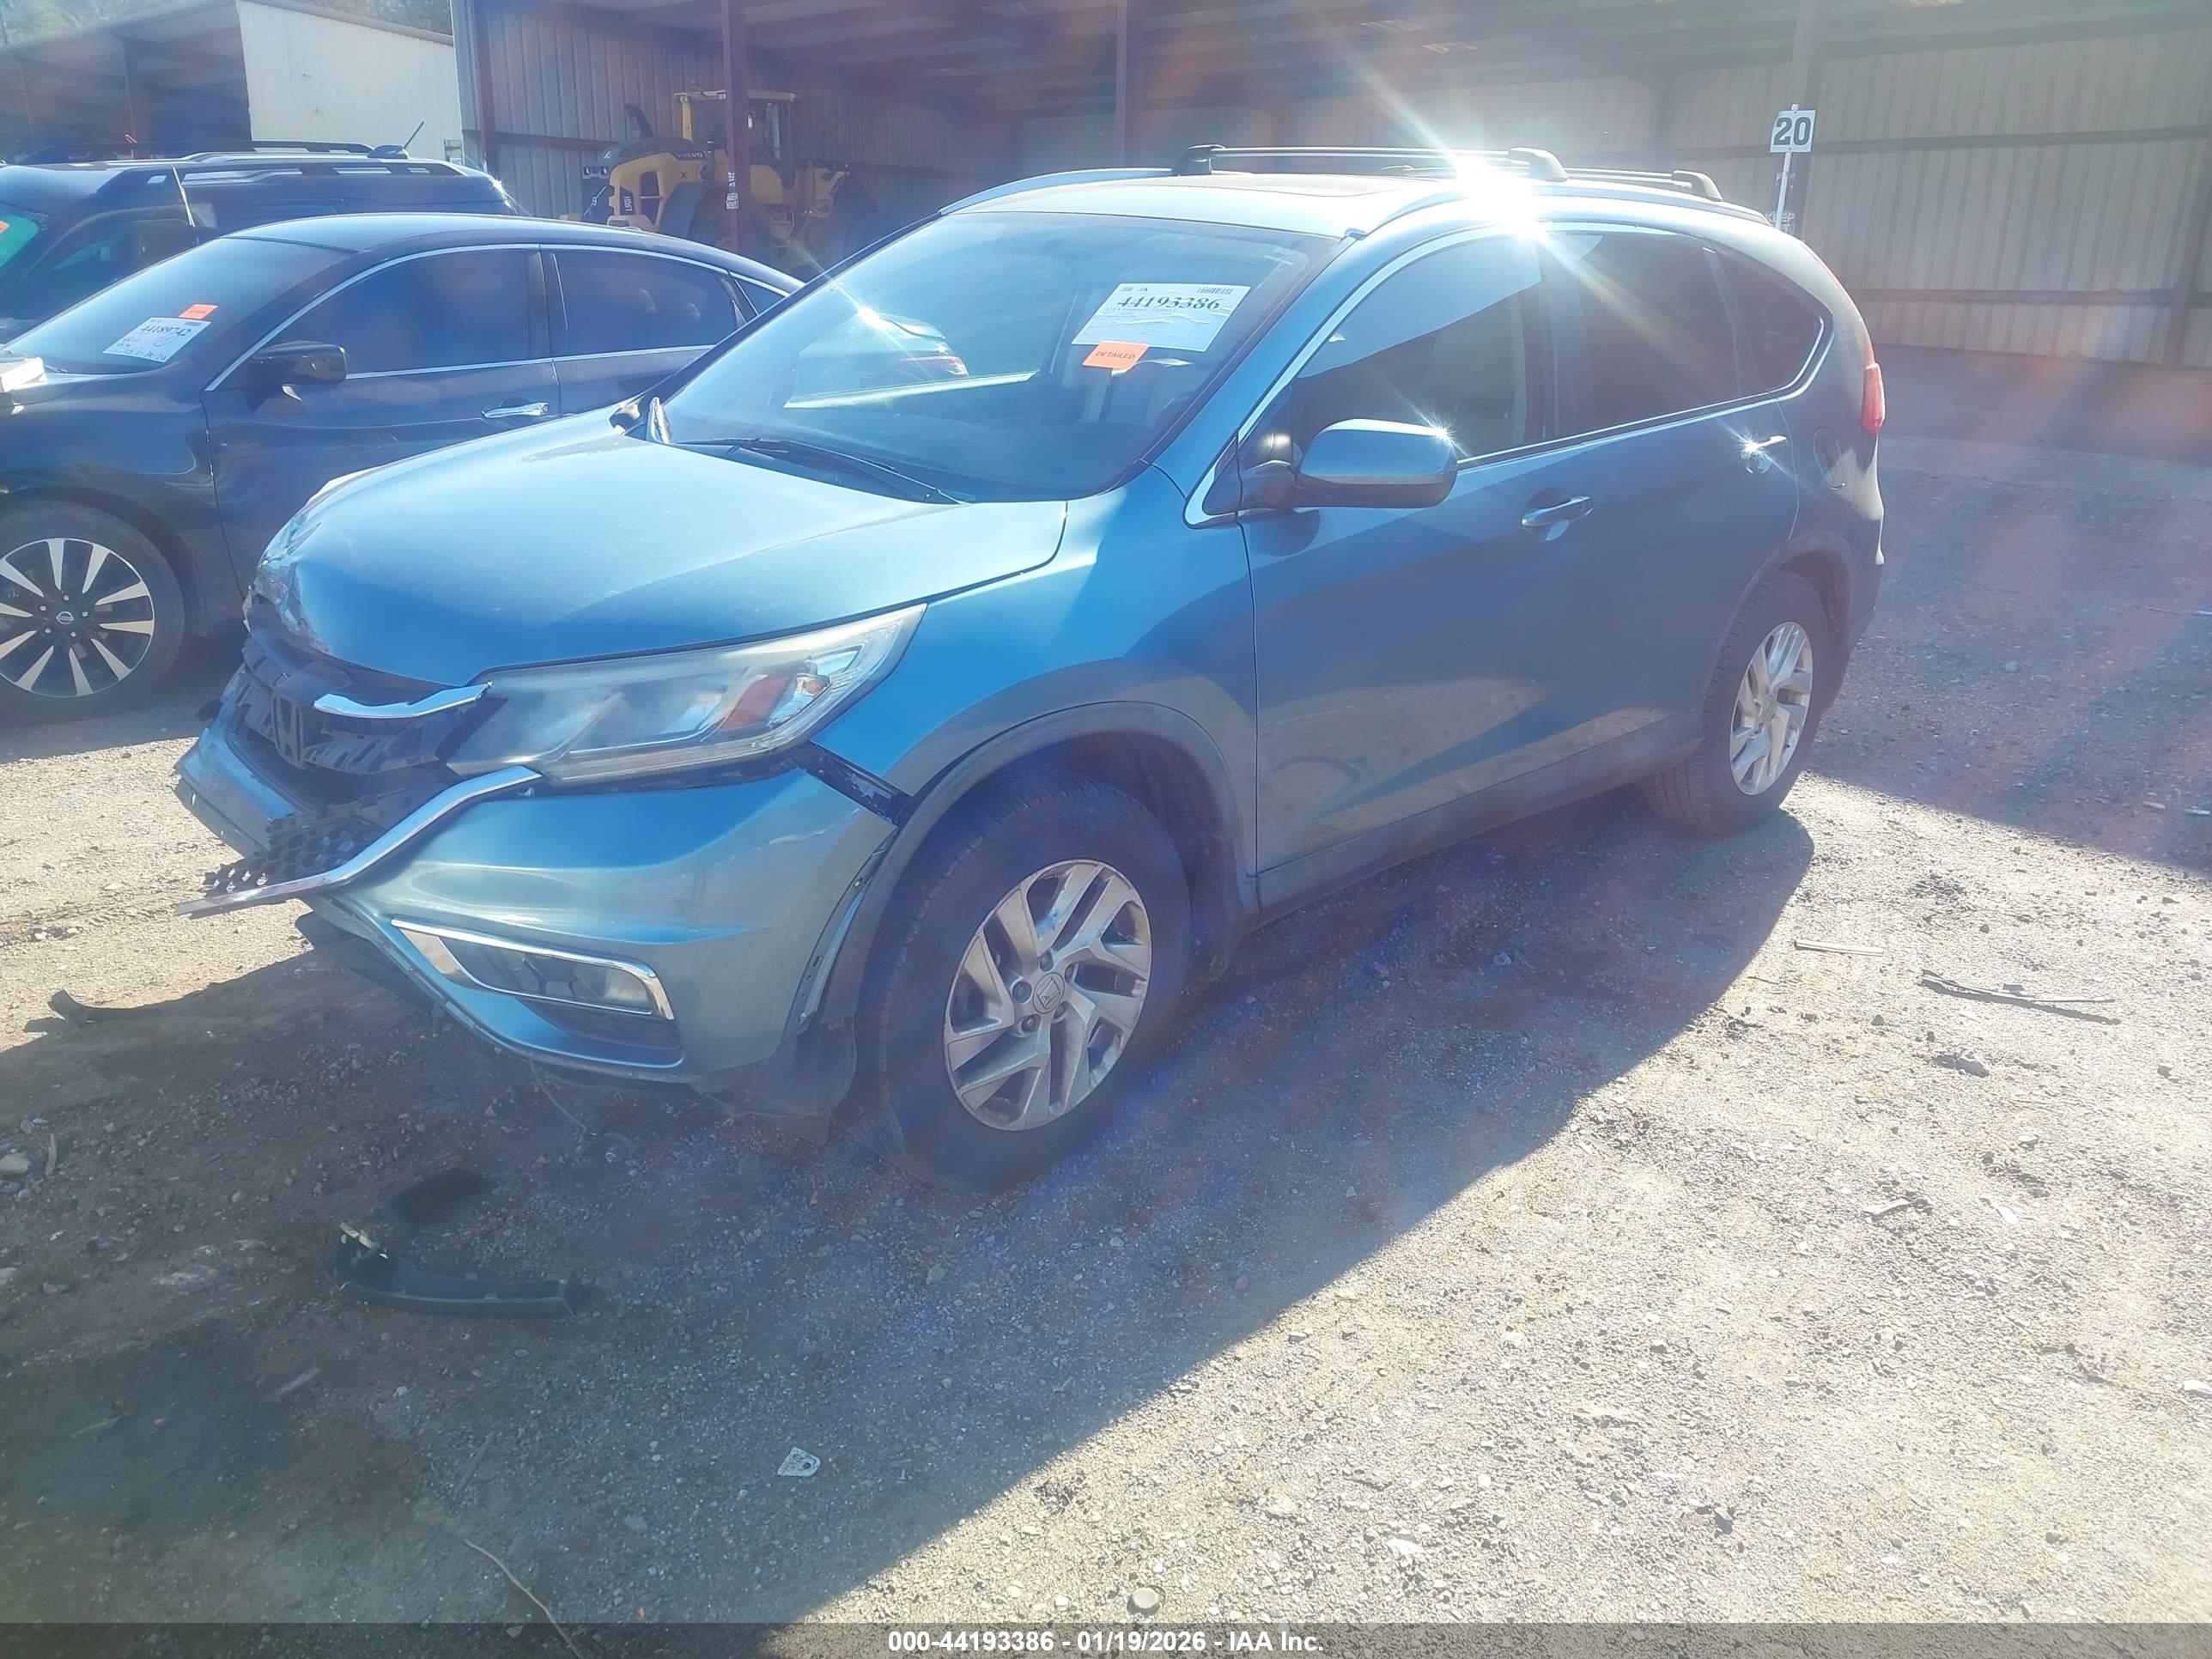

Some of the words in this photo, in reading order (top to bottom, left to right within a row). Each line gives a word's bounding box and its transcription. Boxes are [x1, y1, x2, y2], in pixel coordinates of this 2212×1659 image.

[1773, 117, 1811, 145] 20
[1117, 296, 1223, 311] 44193386
[1095, 350, 1135, 359] DETAILED
